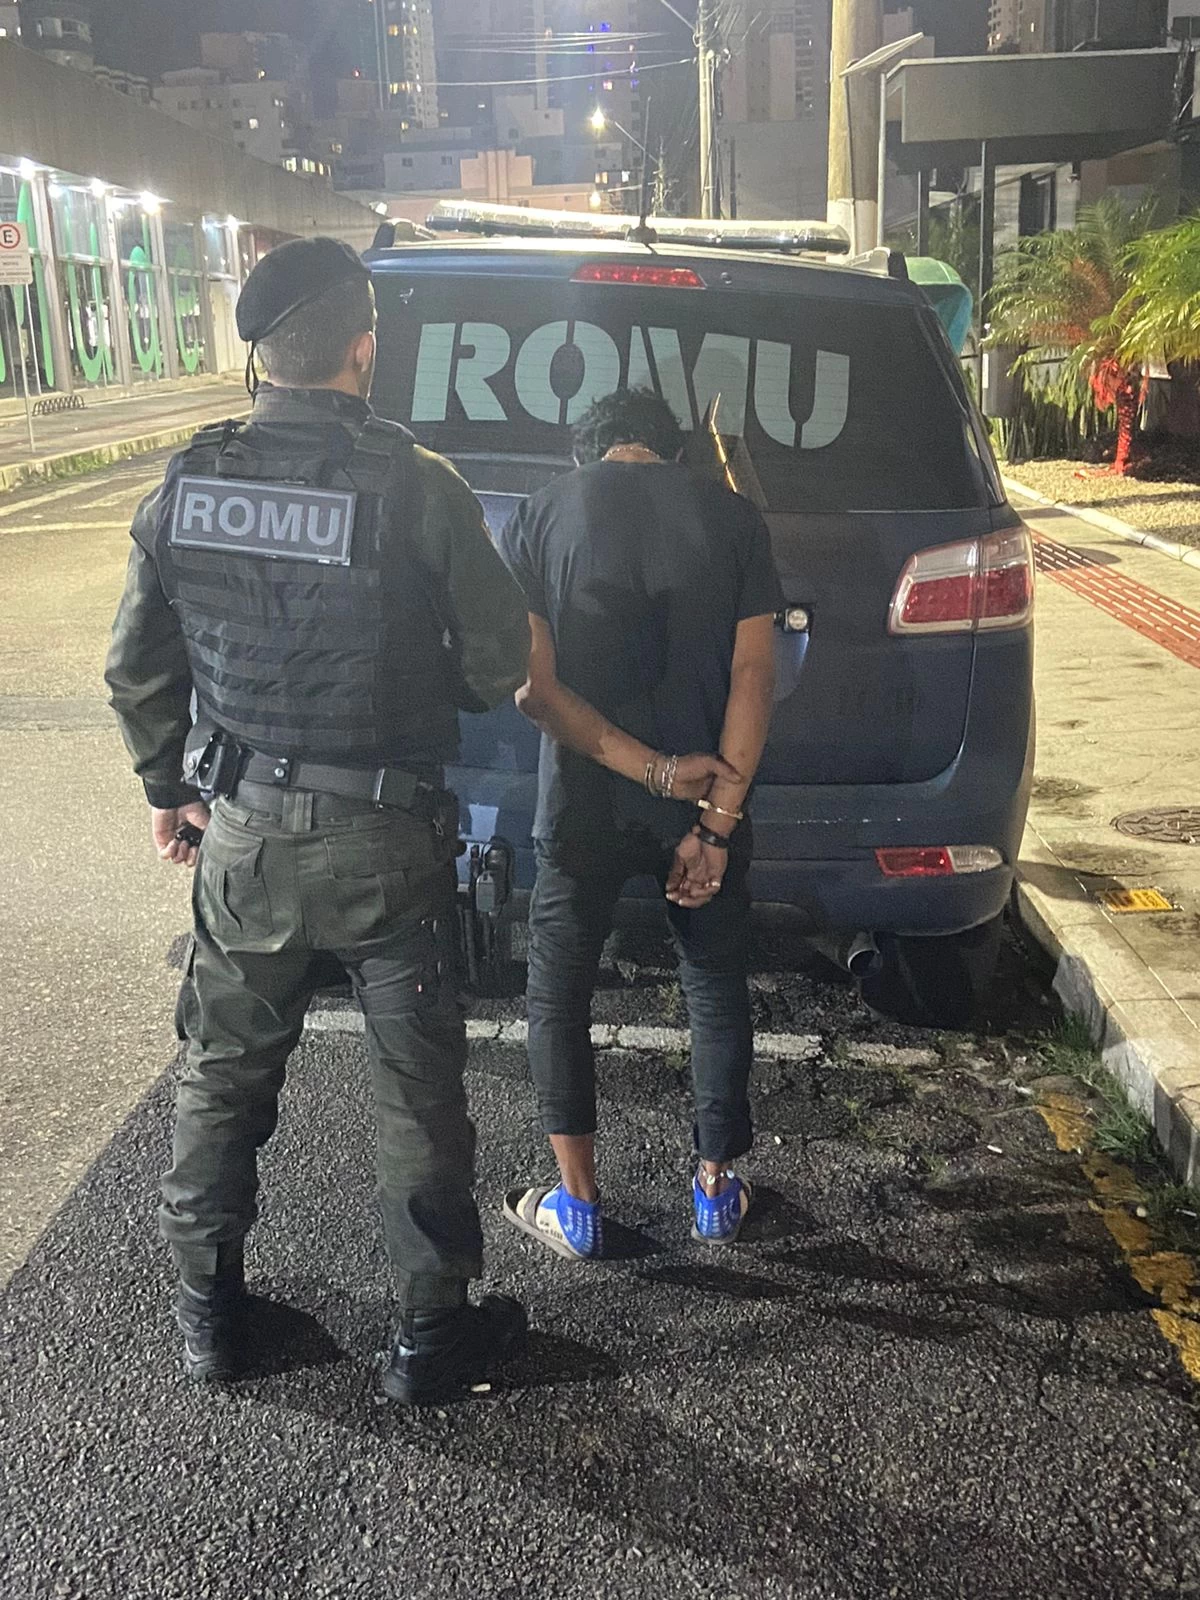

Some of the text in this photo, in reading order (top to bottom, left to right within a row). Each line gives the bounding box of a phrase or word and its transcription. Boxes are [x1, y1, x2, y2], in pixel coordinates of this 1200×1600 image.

[3, 229, 14, 243] E
[411, 320, 850, 450] ROMU
[182, 492, 342, 546] ROMU
